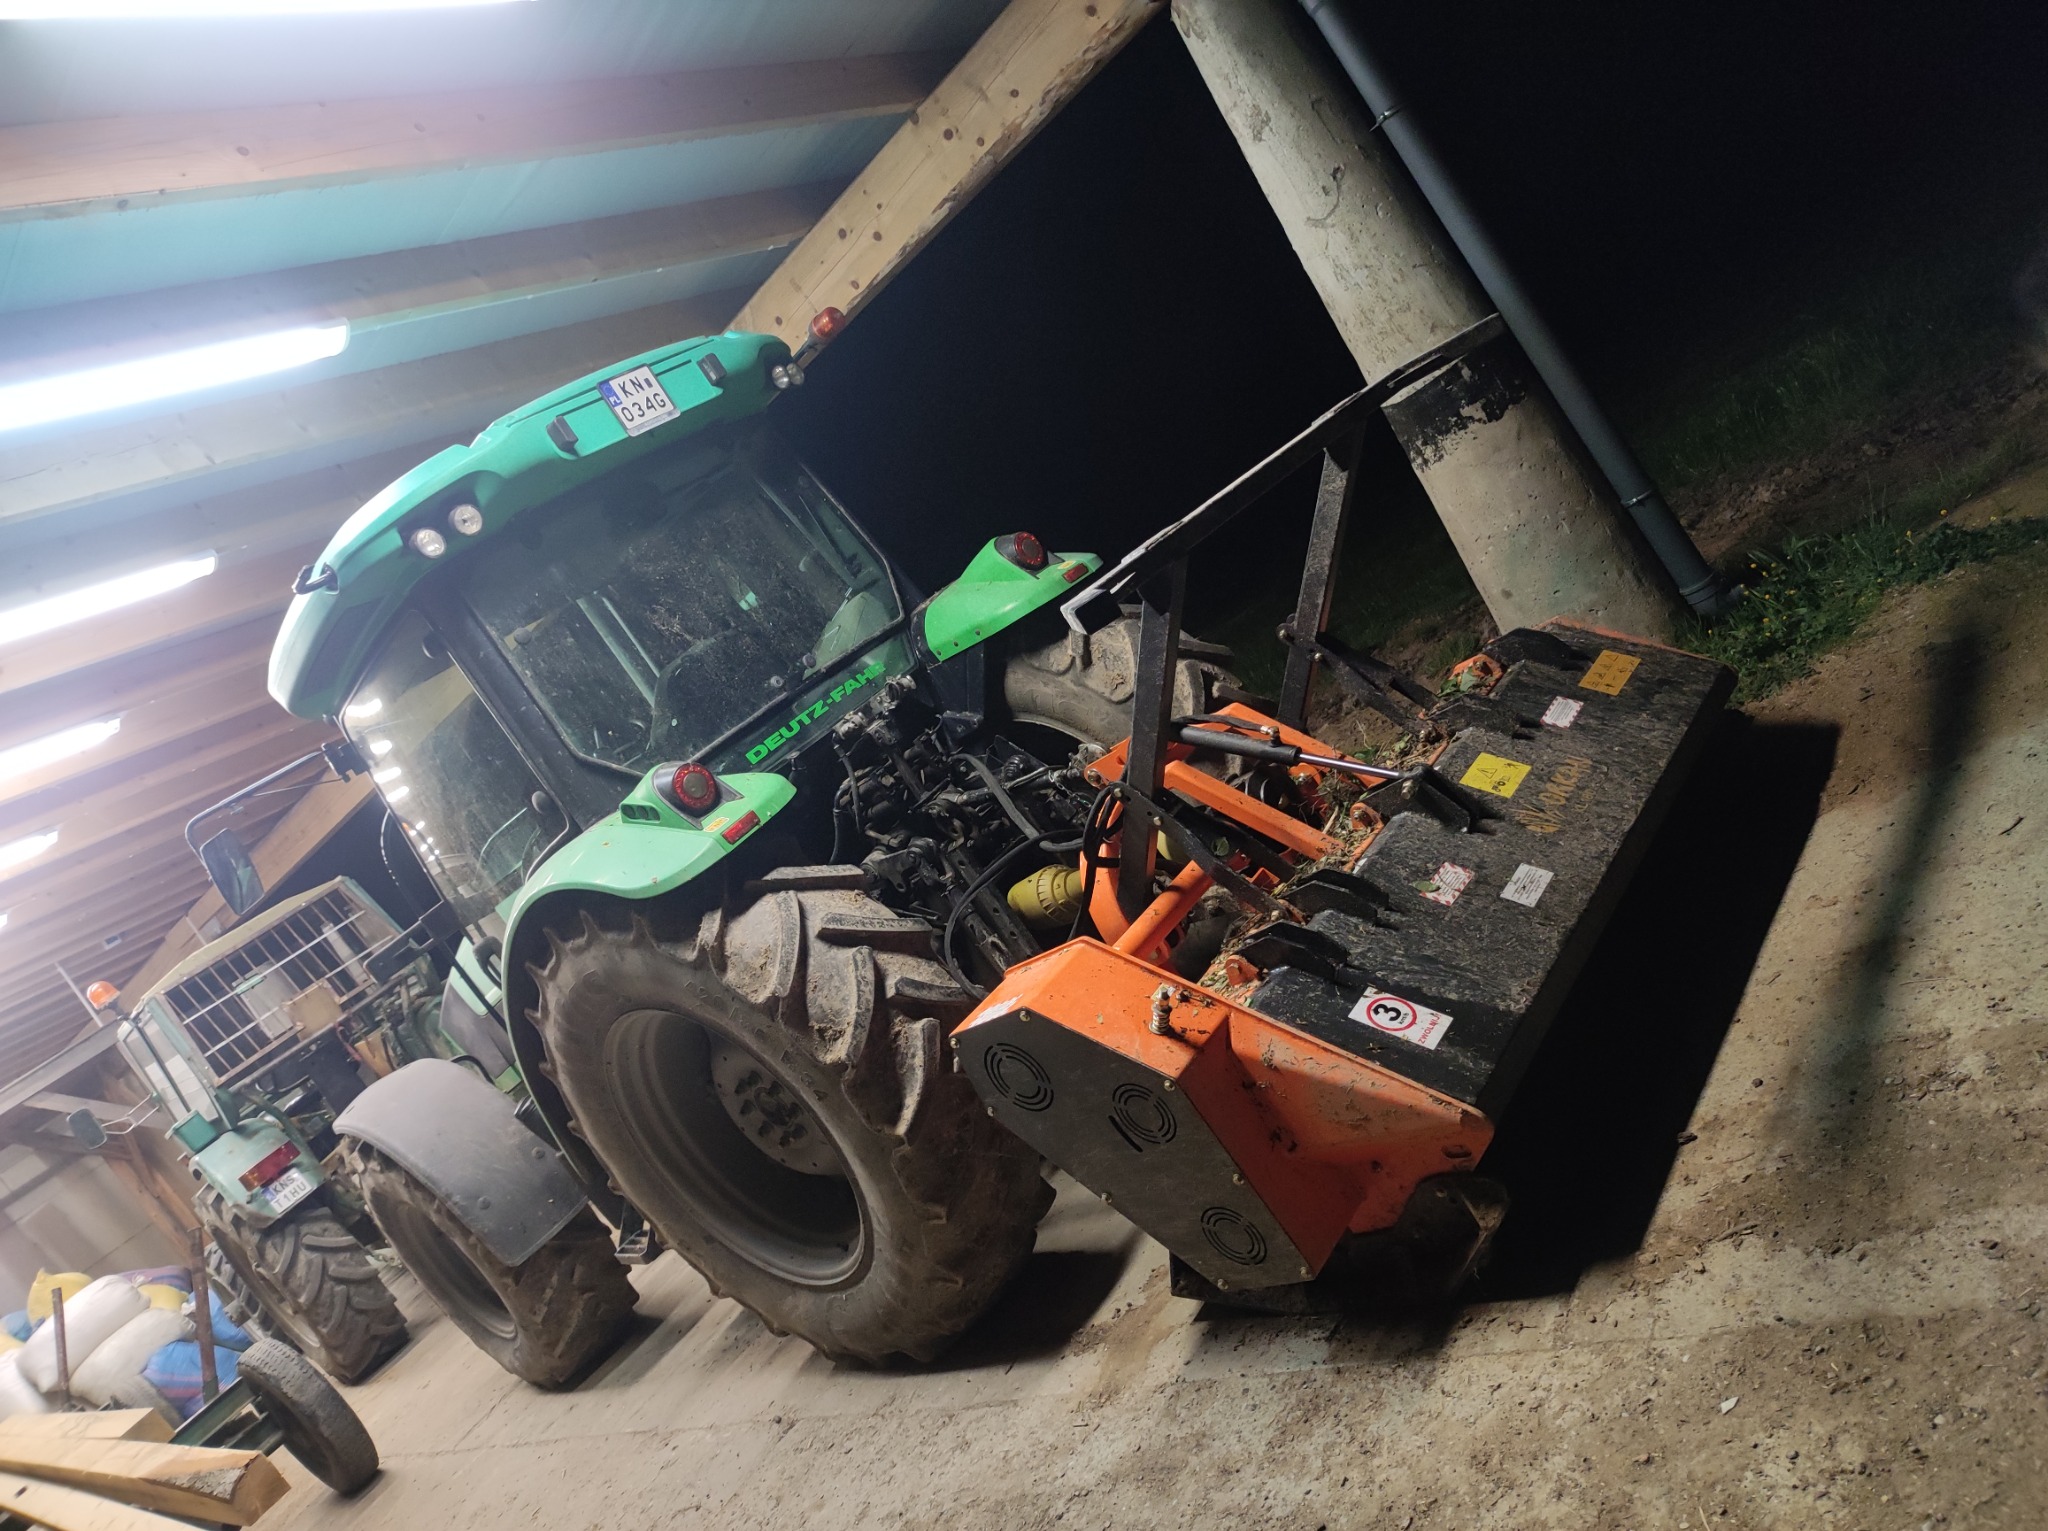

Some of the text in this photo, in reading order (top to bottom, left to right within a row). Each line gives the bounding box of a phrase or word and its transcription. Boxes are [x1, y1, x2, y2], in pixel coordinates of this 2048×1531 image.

[617, 376, 645, 399] KN
[608, 396, 621, 406] PL
[620, 392, 666, 422] 034G
[745, 661, 886, 765] DEUTZ-FAHR
[1372, 1003, 1402, 1022] 3
